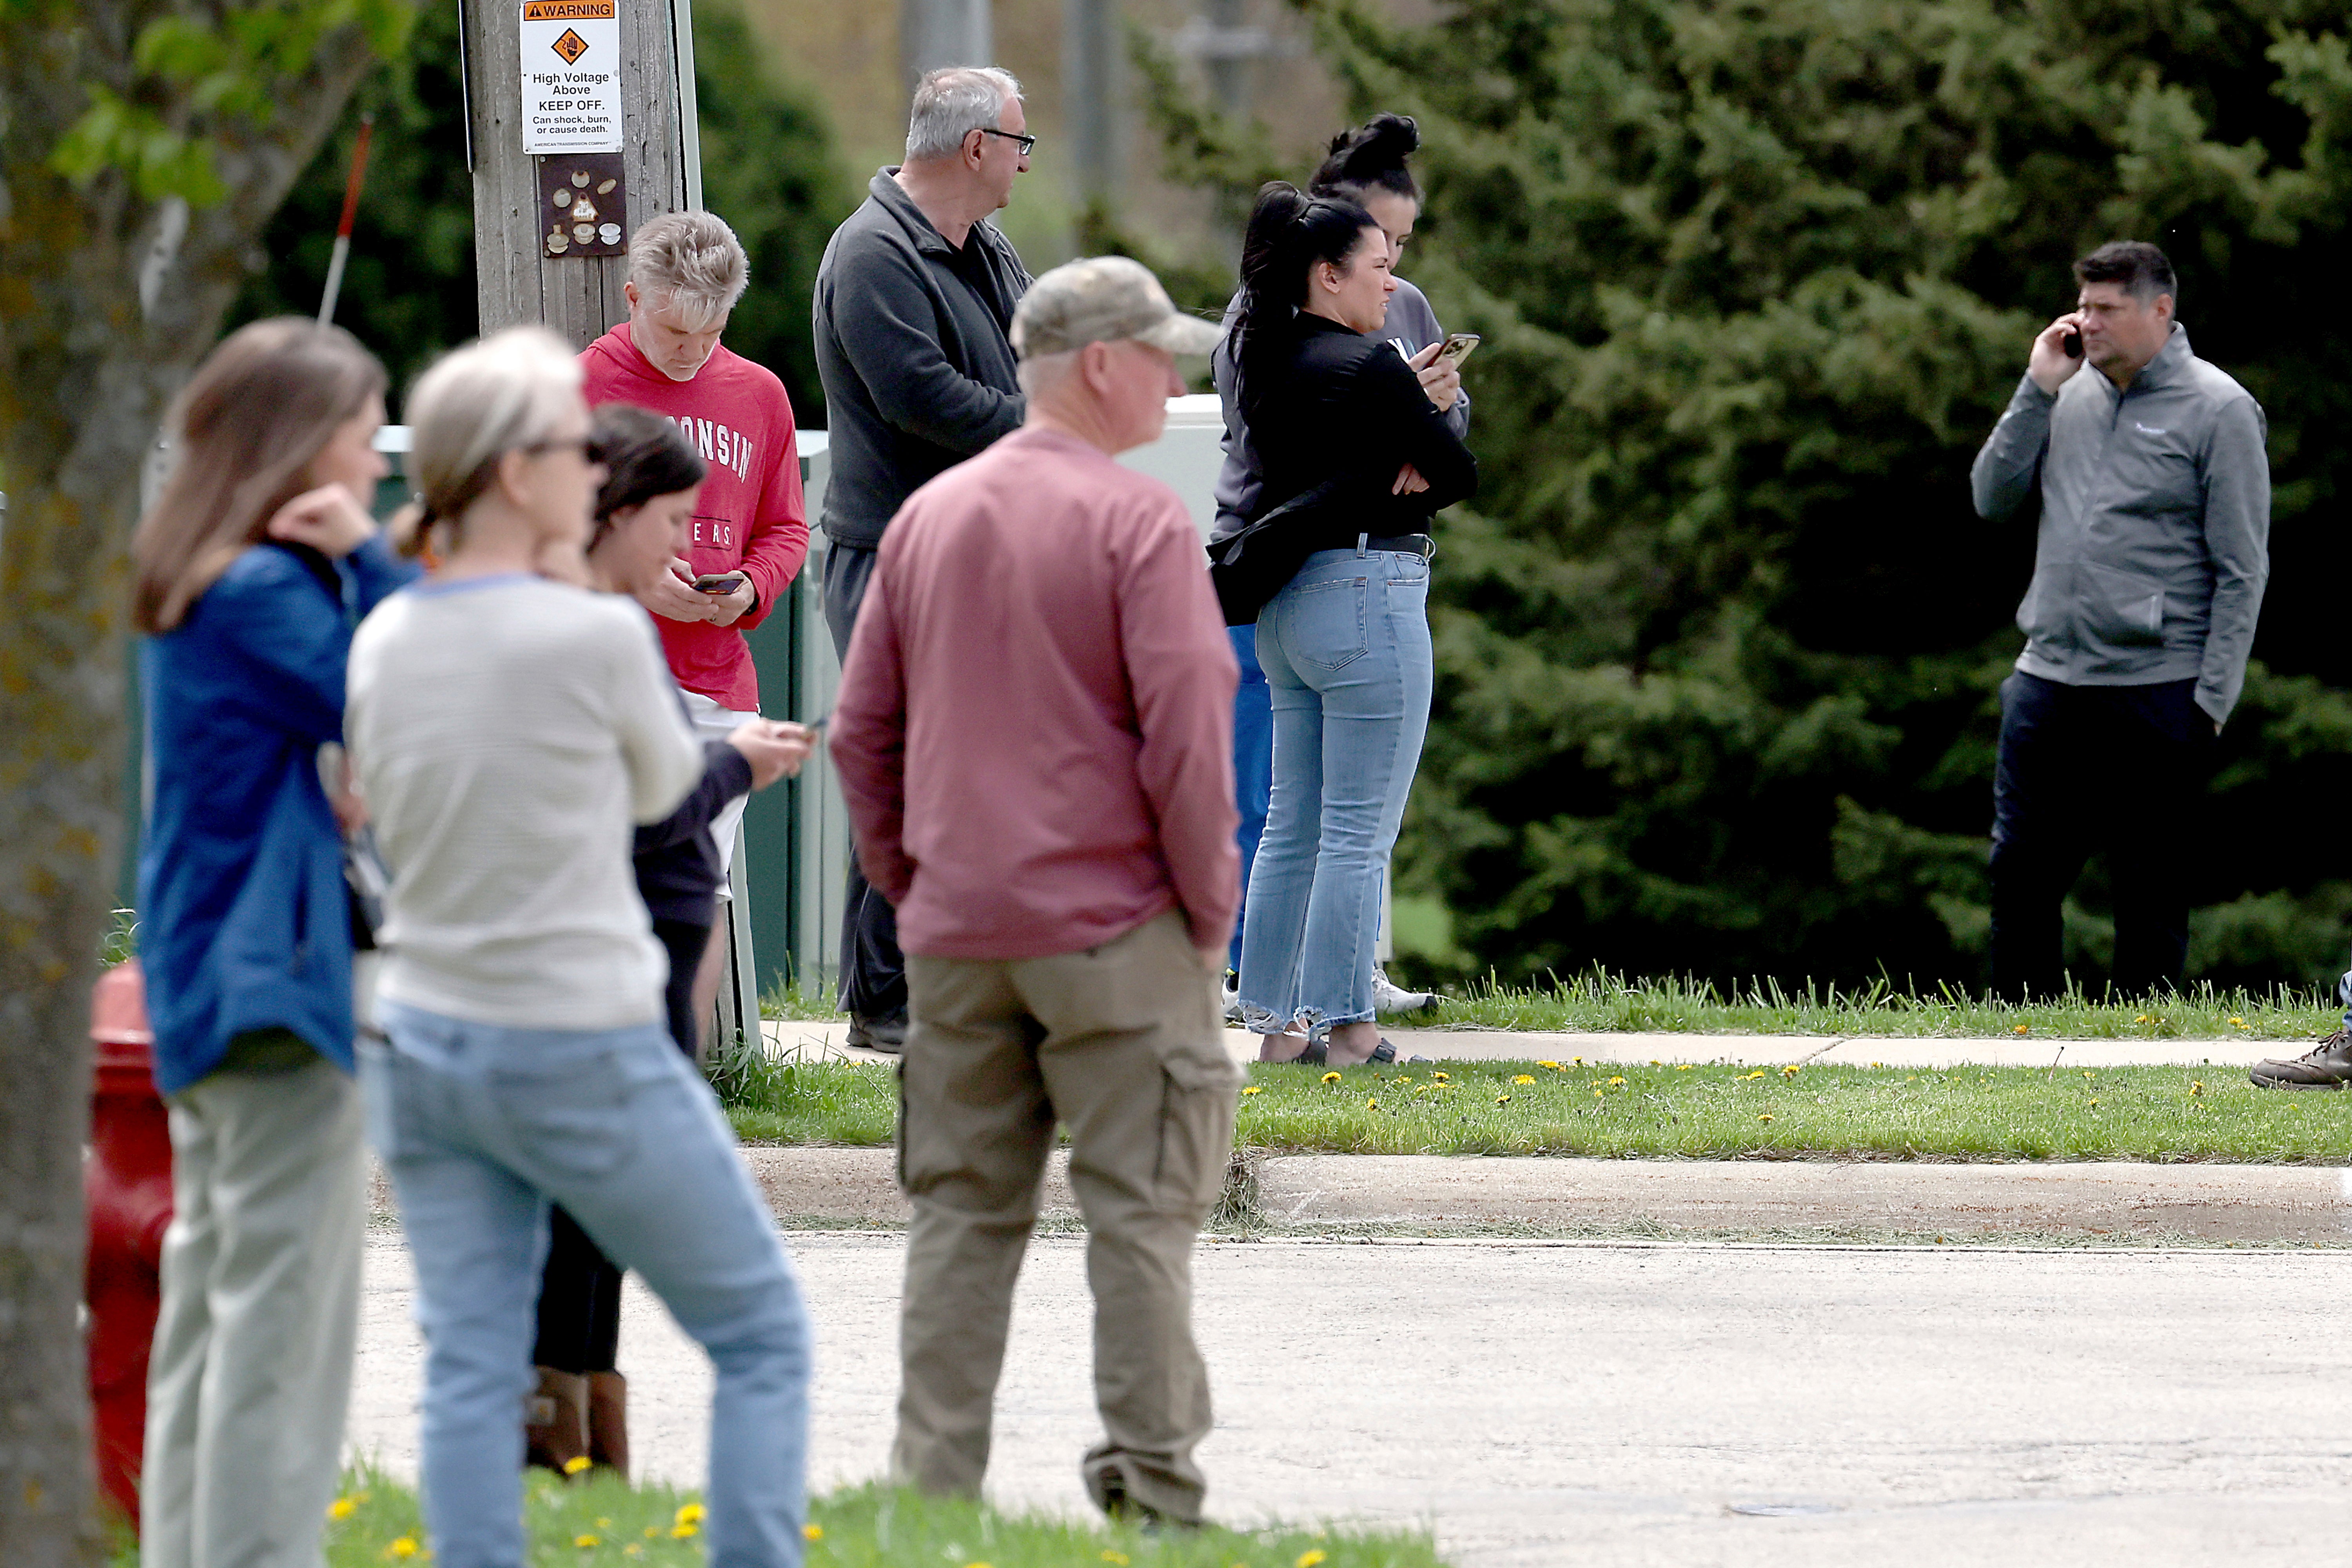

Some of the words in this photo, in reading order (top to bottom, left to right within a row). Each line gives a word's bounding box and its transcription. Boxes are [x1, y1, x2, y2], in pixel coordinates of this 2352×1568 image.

[544, 4, 610, 16] WARNING
[534, 73, 560, 85] High
[564, 73, 609, 84] Voltage
[553, 85, 591, 95] Above
[539, 101, 573, 111] KEEP
[577, 100, 605, 110] OFF.
[554, 116, 585, 124] shock,
[588, 115, 612, 124] burn,
[665, 415, 753, 483] ONSIN
